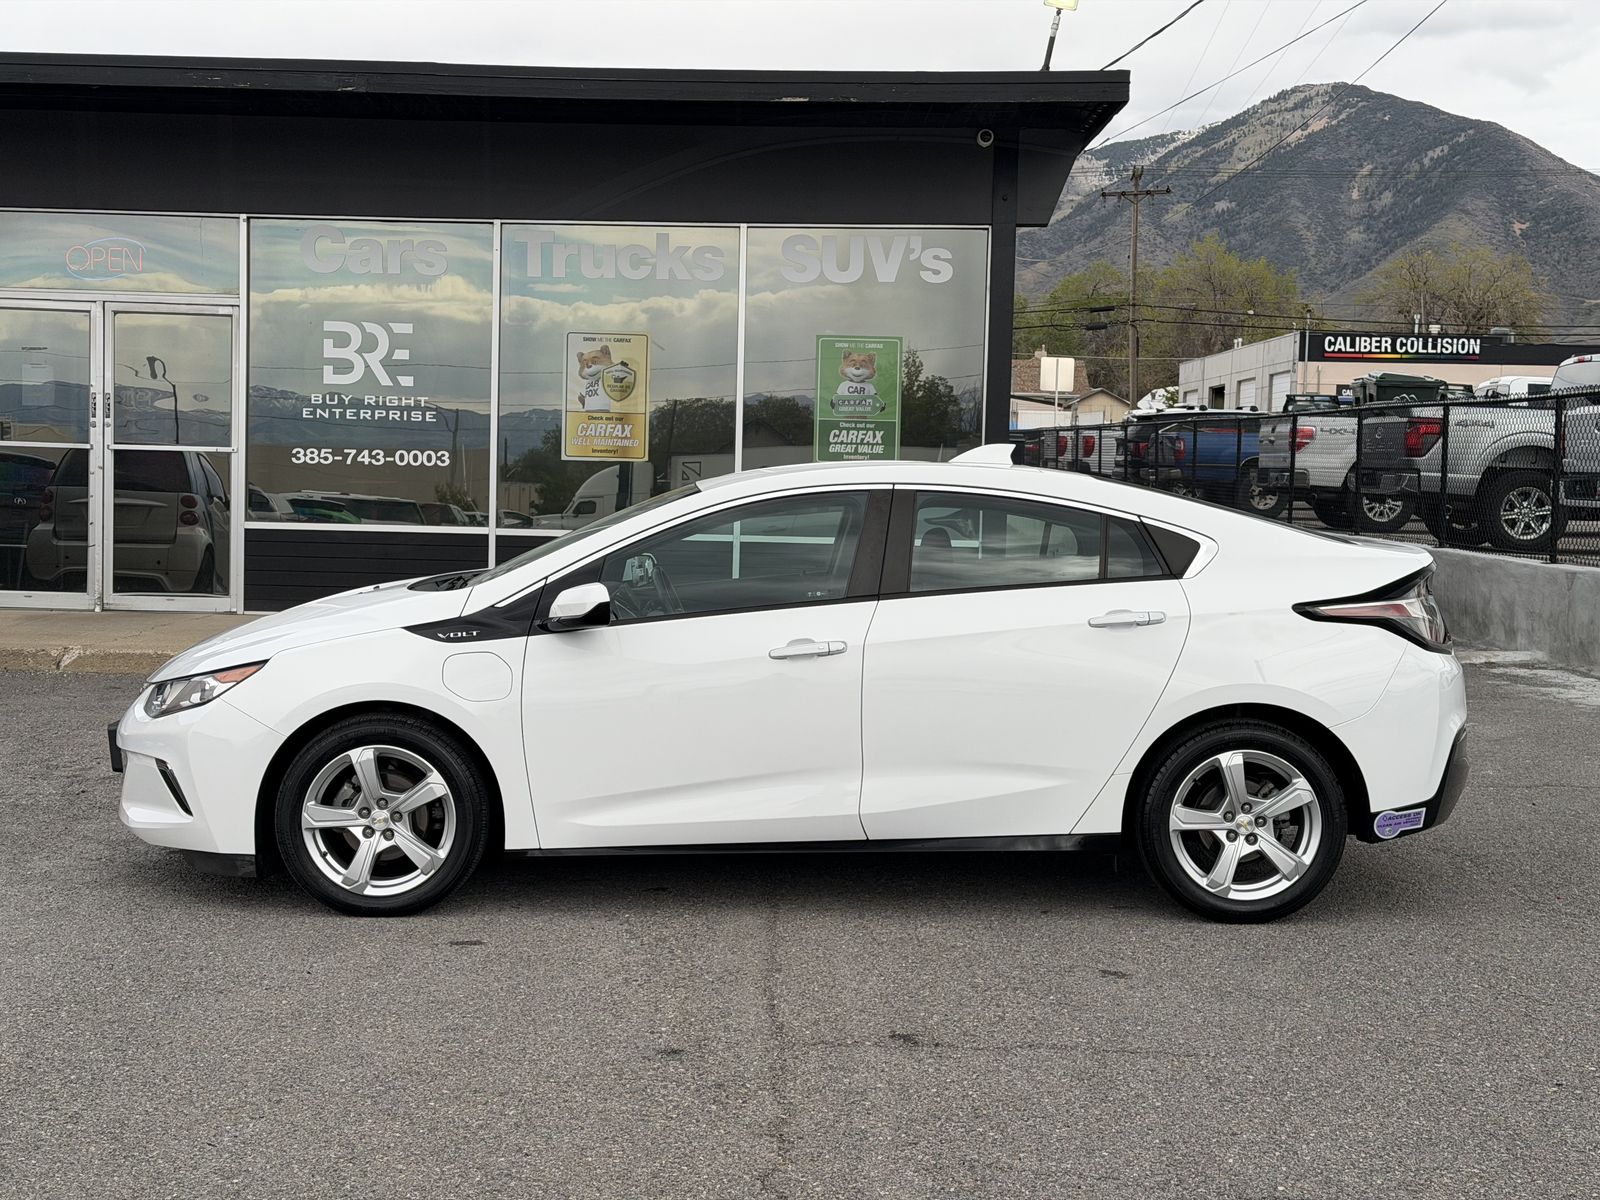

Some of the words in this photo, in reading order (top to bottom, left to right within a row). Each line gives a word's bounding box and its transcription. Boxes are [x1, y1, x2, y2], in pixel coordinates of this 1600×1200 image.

[300, 224, 448, 276] Cars
[514, 230, 725, 281] Trucks
[65, 245, 144, 272] OPEN
[781, 234, 954, 284] SUV's
[1324, 336, 1392, 353] CALIBER
[1396, 337, 1481, 354] COLLISION
[323, 320, 414, 387] BRE
[847, 386, 866, 394] CAR
[310, 393, 353, 405] BUY
[364, 395, 429, 408] RIGHT
[302, 407, 437, 422] ENTERPRISE
[577, 423, 633, 438] CARFAX
[829, 429, 885, 444] CARFAX
[571, 436, 591, 446] WELL
[592, 438, 640, 447] MAINTAINED
[829, 444, 857, 453] GREAT
[857, 444, 885, 454] VALUE
[291, 447, 450, 467] 385-743-0003
[592, 447, 619, 455] Inventory!
[437, 630, 481, 639] VOLT
